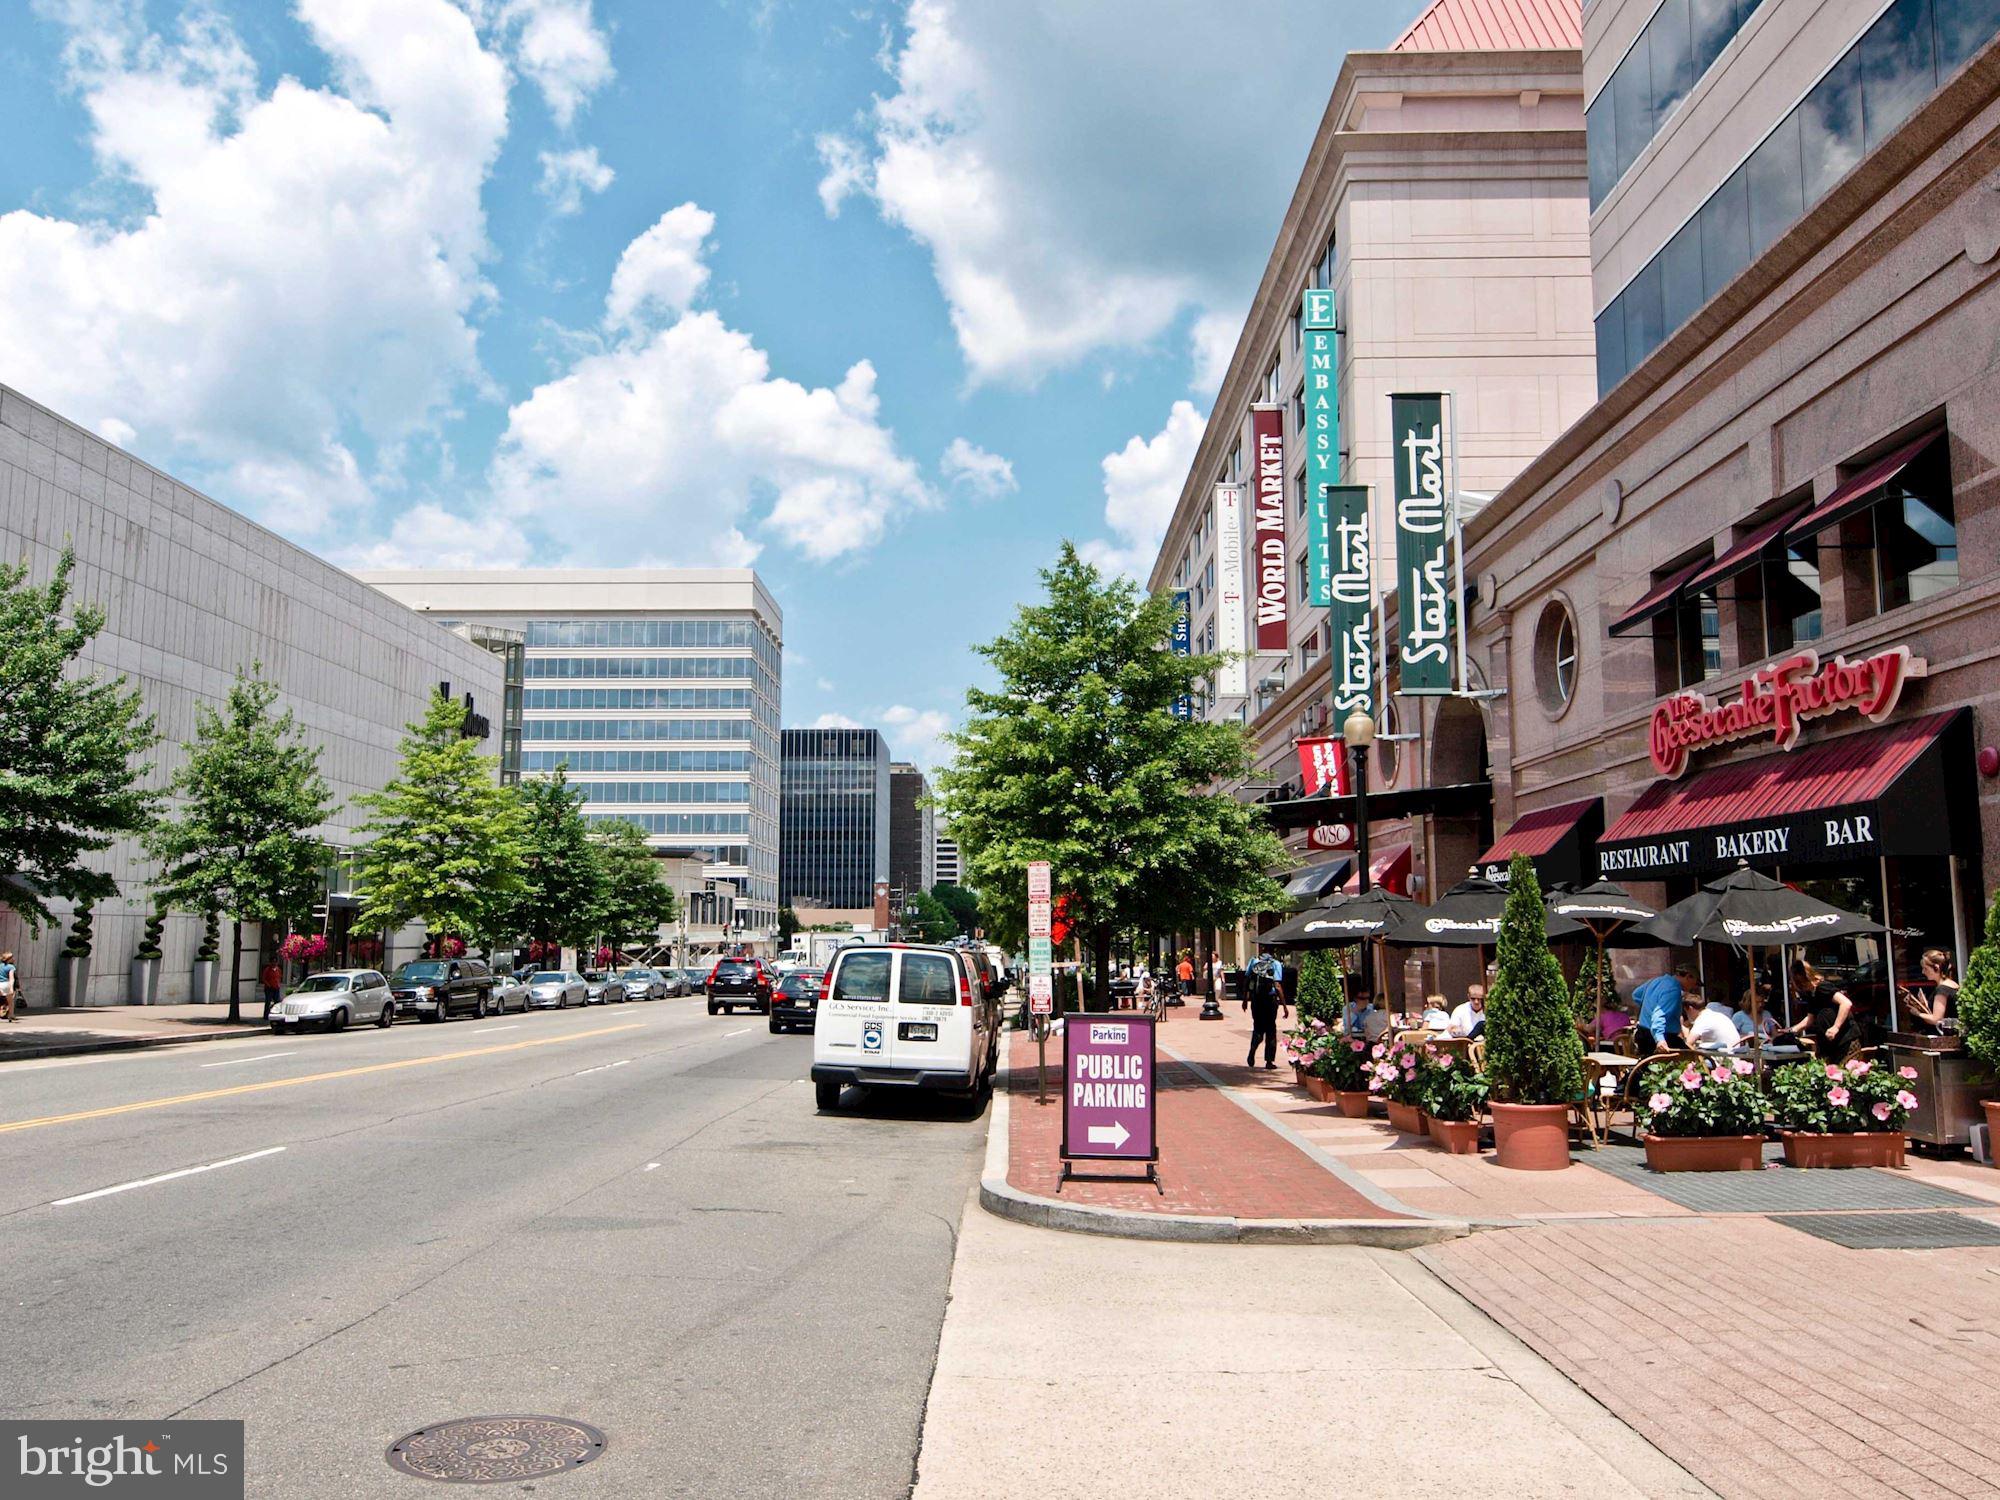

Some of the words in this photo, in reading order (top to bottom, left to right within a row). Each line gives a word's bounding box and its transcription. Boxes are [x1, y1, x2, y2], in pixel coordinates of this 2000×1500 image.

[1311, 335, 1331, 470] EMBASSY
[1223, 490, 1237, 507] T
[1256, 433, 1284, 532] MARKET
[1398, 423, 1444, 533] Mart
[1258, 537, 1287, 627] WORLD
[1331, 511, 1370, 603] Mart
[1401, 544, 1448, 664] Stein
[1333, 611, 1371, 712] Stein
[1649, 679, 1776, 776] Cheesecake
[1757, 652, 1903, 747] Factory
[1669, 695, 1701, 721] The
[1318, 825, 1346, 844] WSC
[1600, 841, 1690, 871] RESTAURANT
[1716, 827, 1790, 859] BAKERY
[1825, 815, 1874, 847] BAR
[864, 1021, 883, 1031] GCS
[1092, 1029, 1127, 1043] Parking
[1073, 1083, 1146, 1108] PARKING
[1076, 1054, 1143, 1080] PUBLIC
